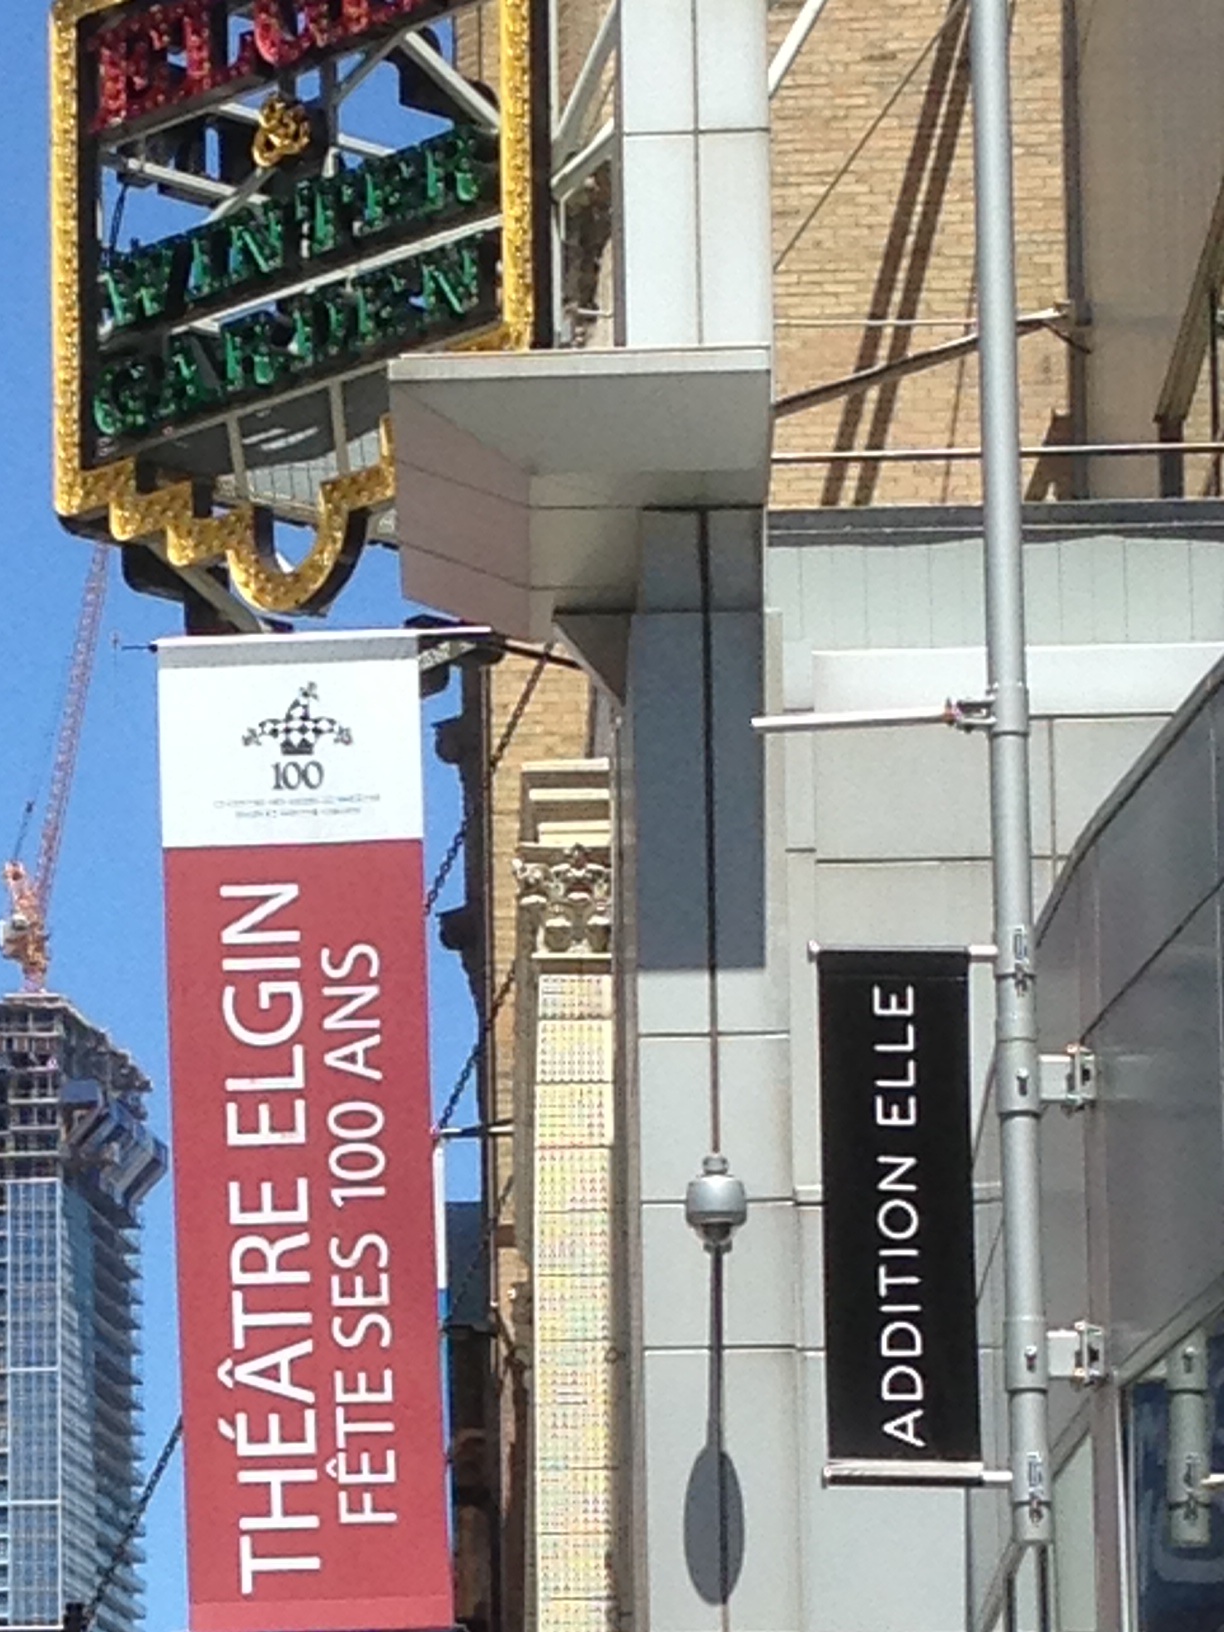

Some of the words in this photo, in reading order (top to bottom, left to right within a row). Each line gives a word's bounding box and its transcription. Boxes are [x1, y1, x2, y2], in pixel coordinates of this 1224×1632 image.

[93, 125, 486, 328] WINTER
[91, 228, 482, 438] GARDEN
[271, 760, 325, 791] 100
[219, 881, 309, 1149] ELGIN
[320, 941, 383, 1081] ANS
[873, 984, 918, 1128] ELLE
[327, 1100, 386, 1208] 100
[329, 1231, 394, 1350] SES
[877, 1154, 927, 1449] ADDITION
[216, 1176, 322, 1596] THÉÂTRE
[326, 1367, 399, 1526] FÊTE
